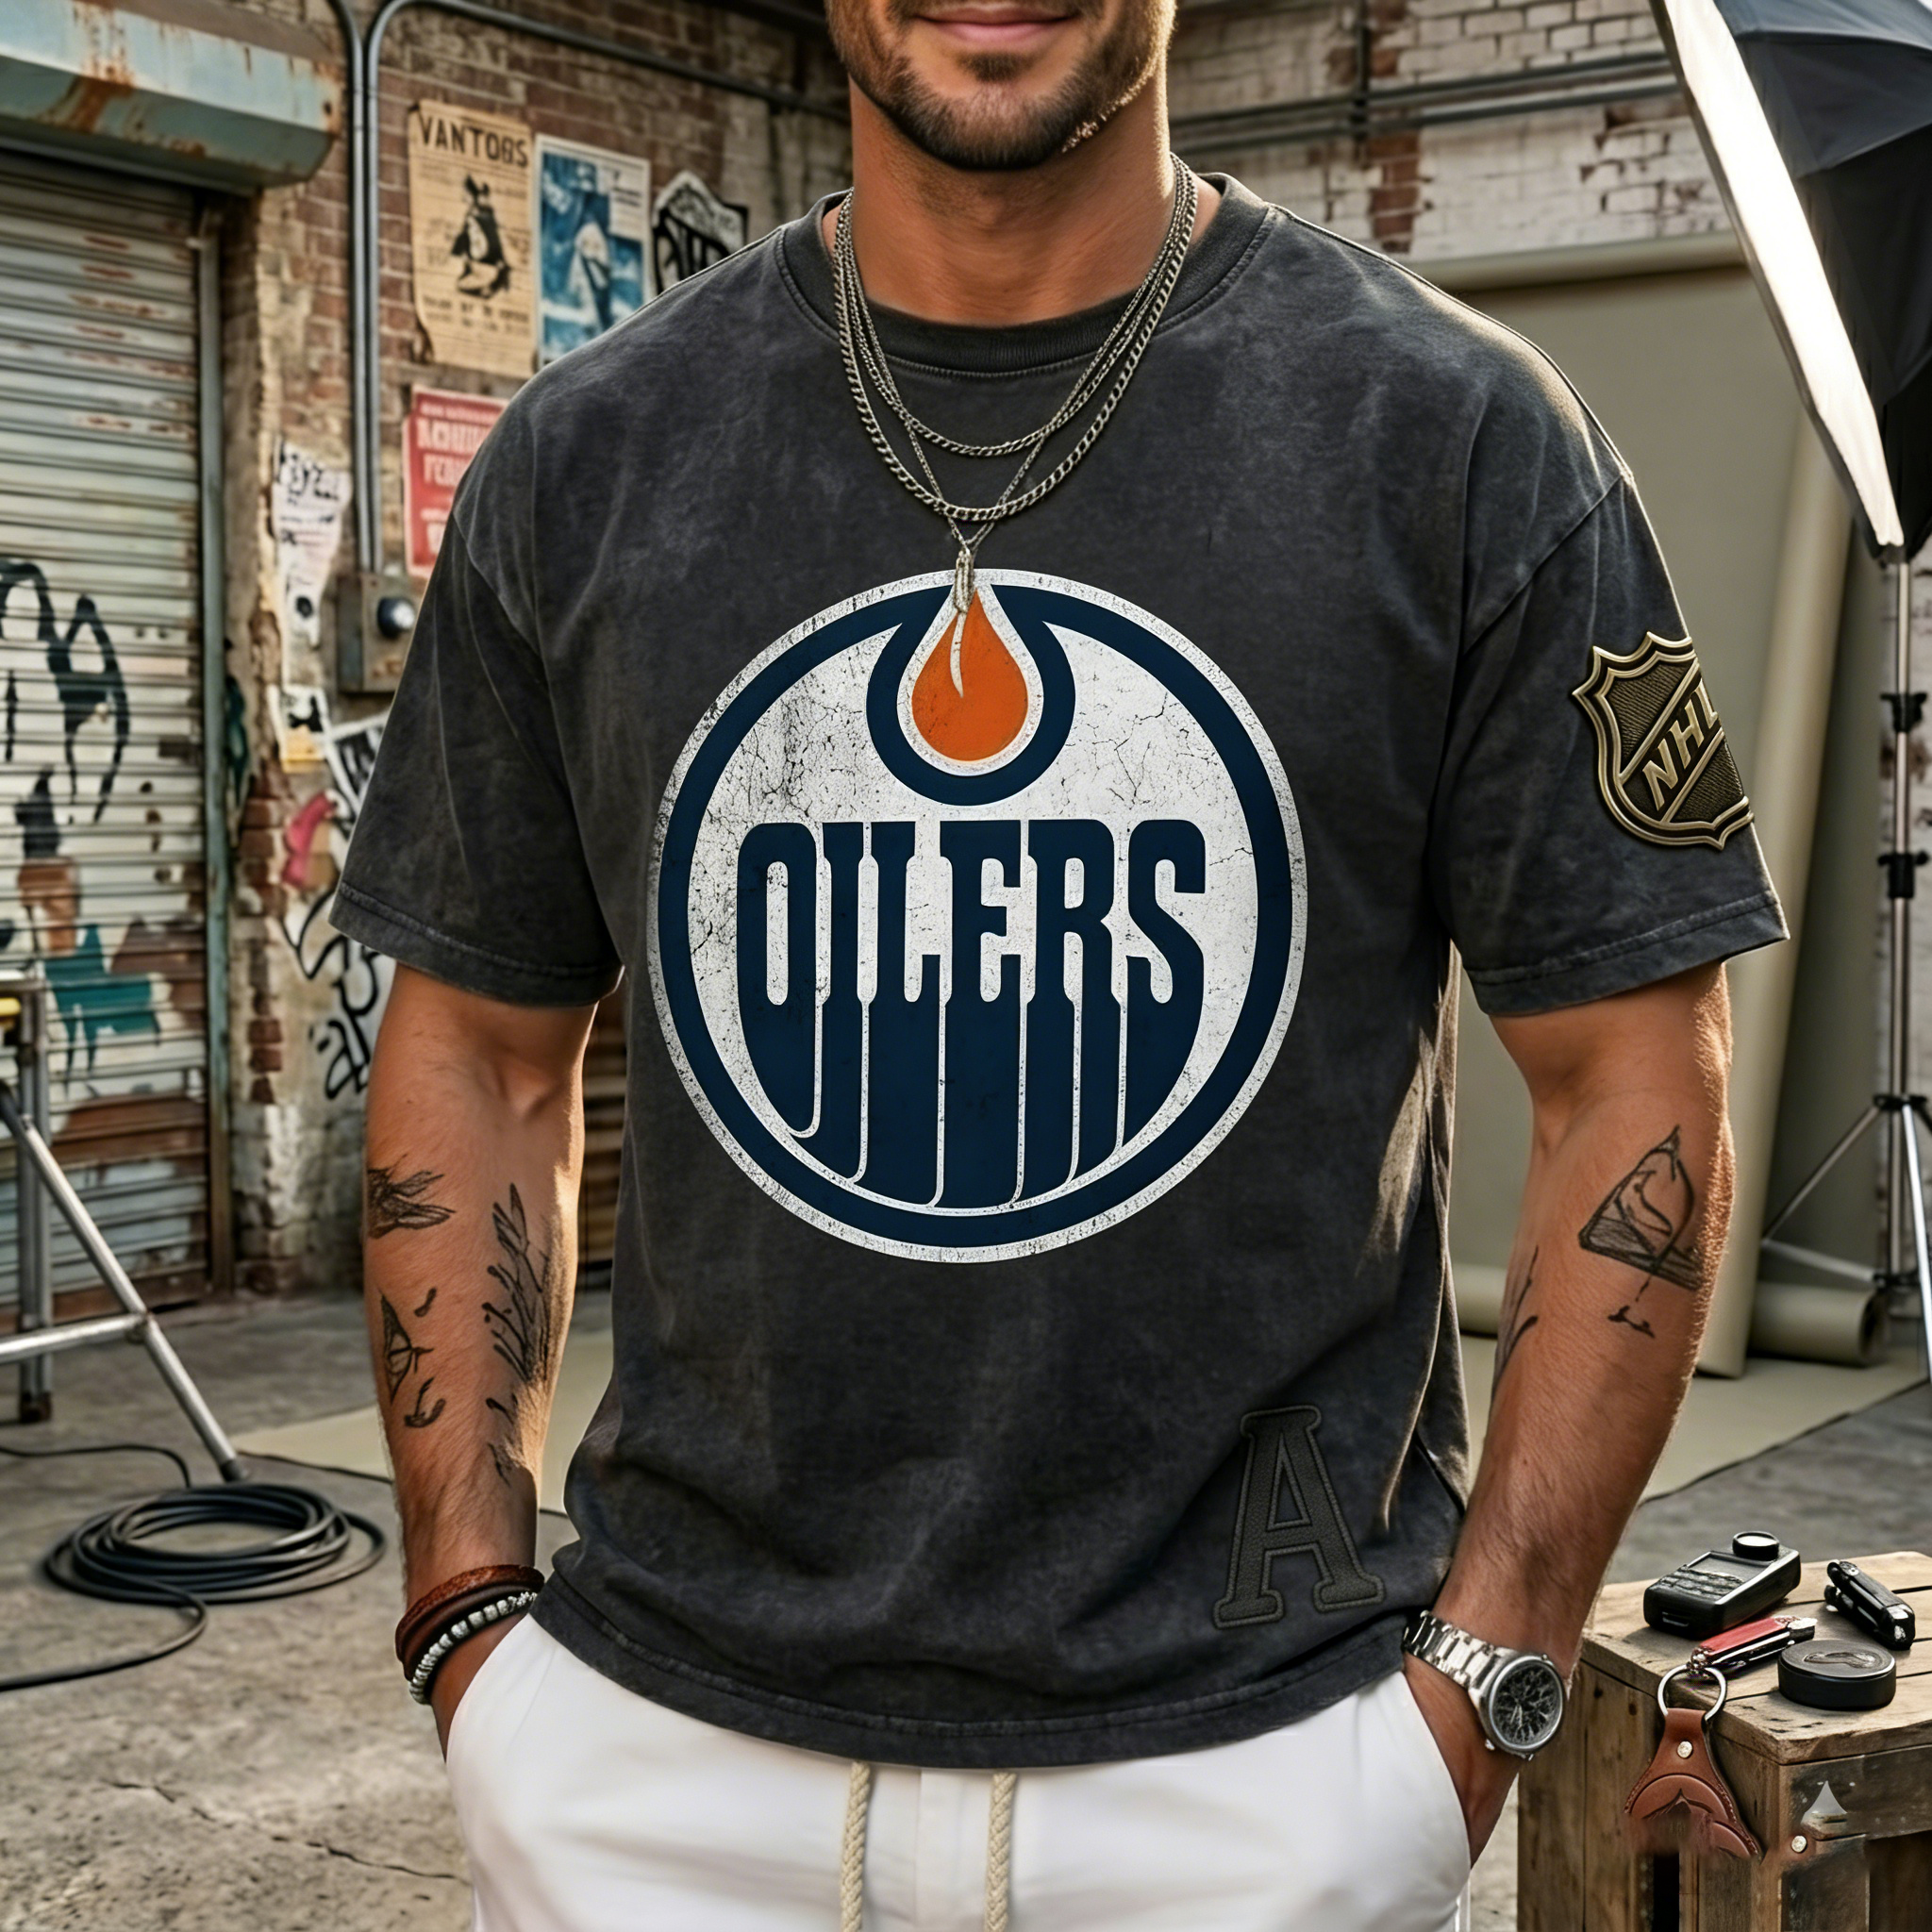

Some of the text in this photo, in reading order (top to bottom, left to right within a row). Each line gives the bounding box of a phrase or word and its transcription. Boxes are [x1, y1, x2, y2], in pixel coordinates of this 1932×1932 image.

[1642, 677, 1719, 811] NHL
[736, 818, 1206, 1209] OILERS
[1213, 1405, 1386, 1629] A
